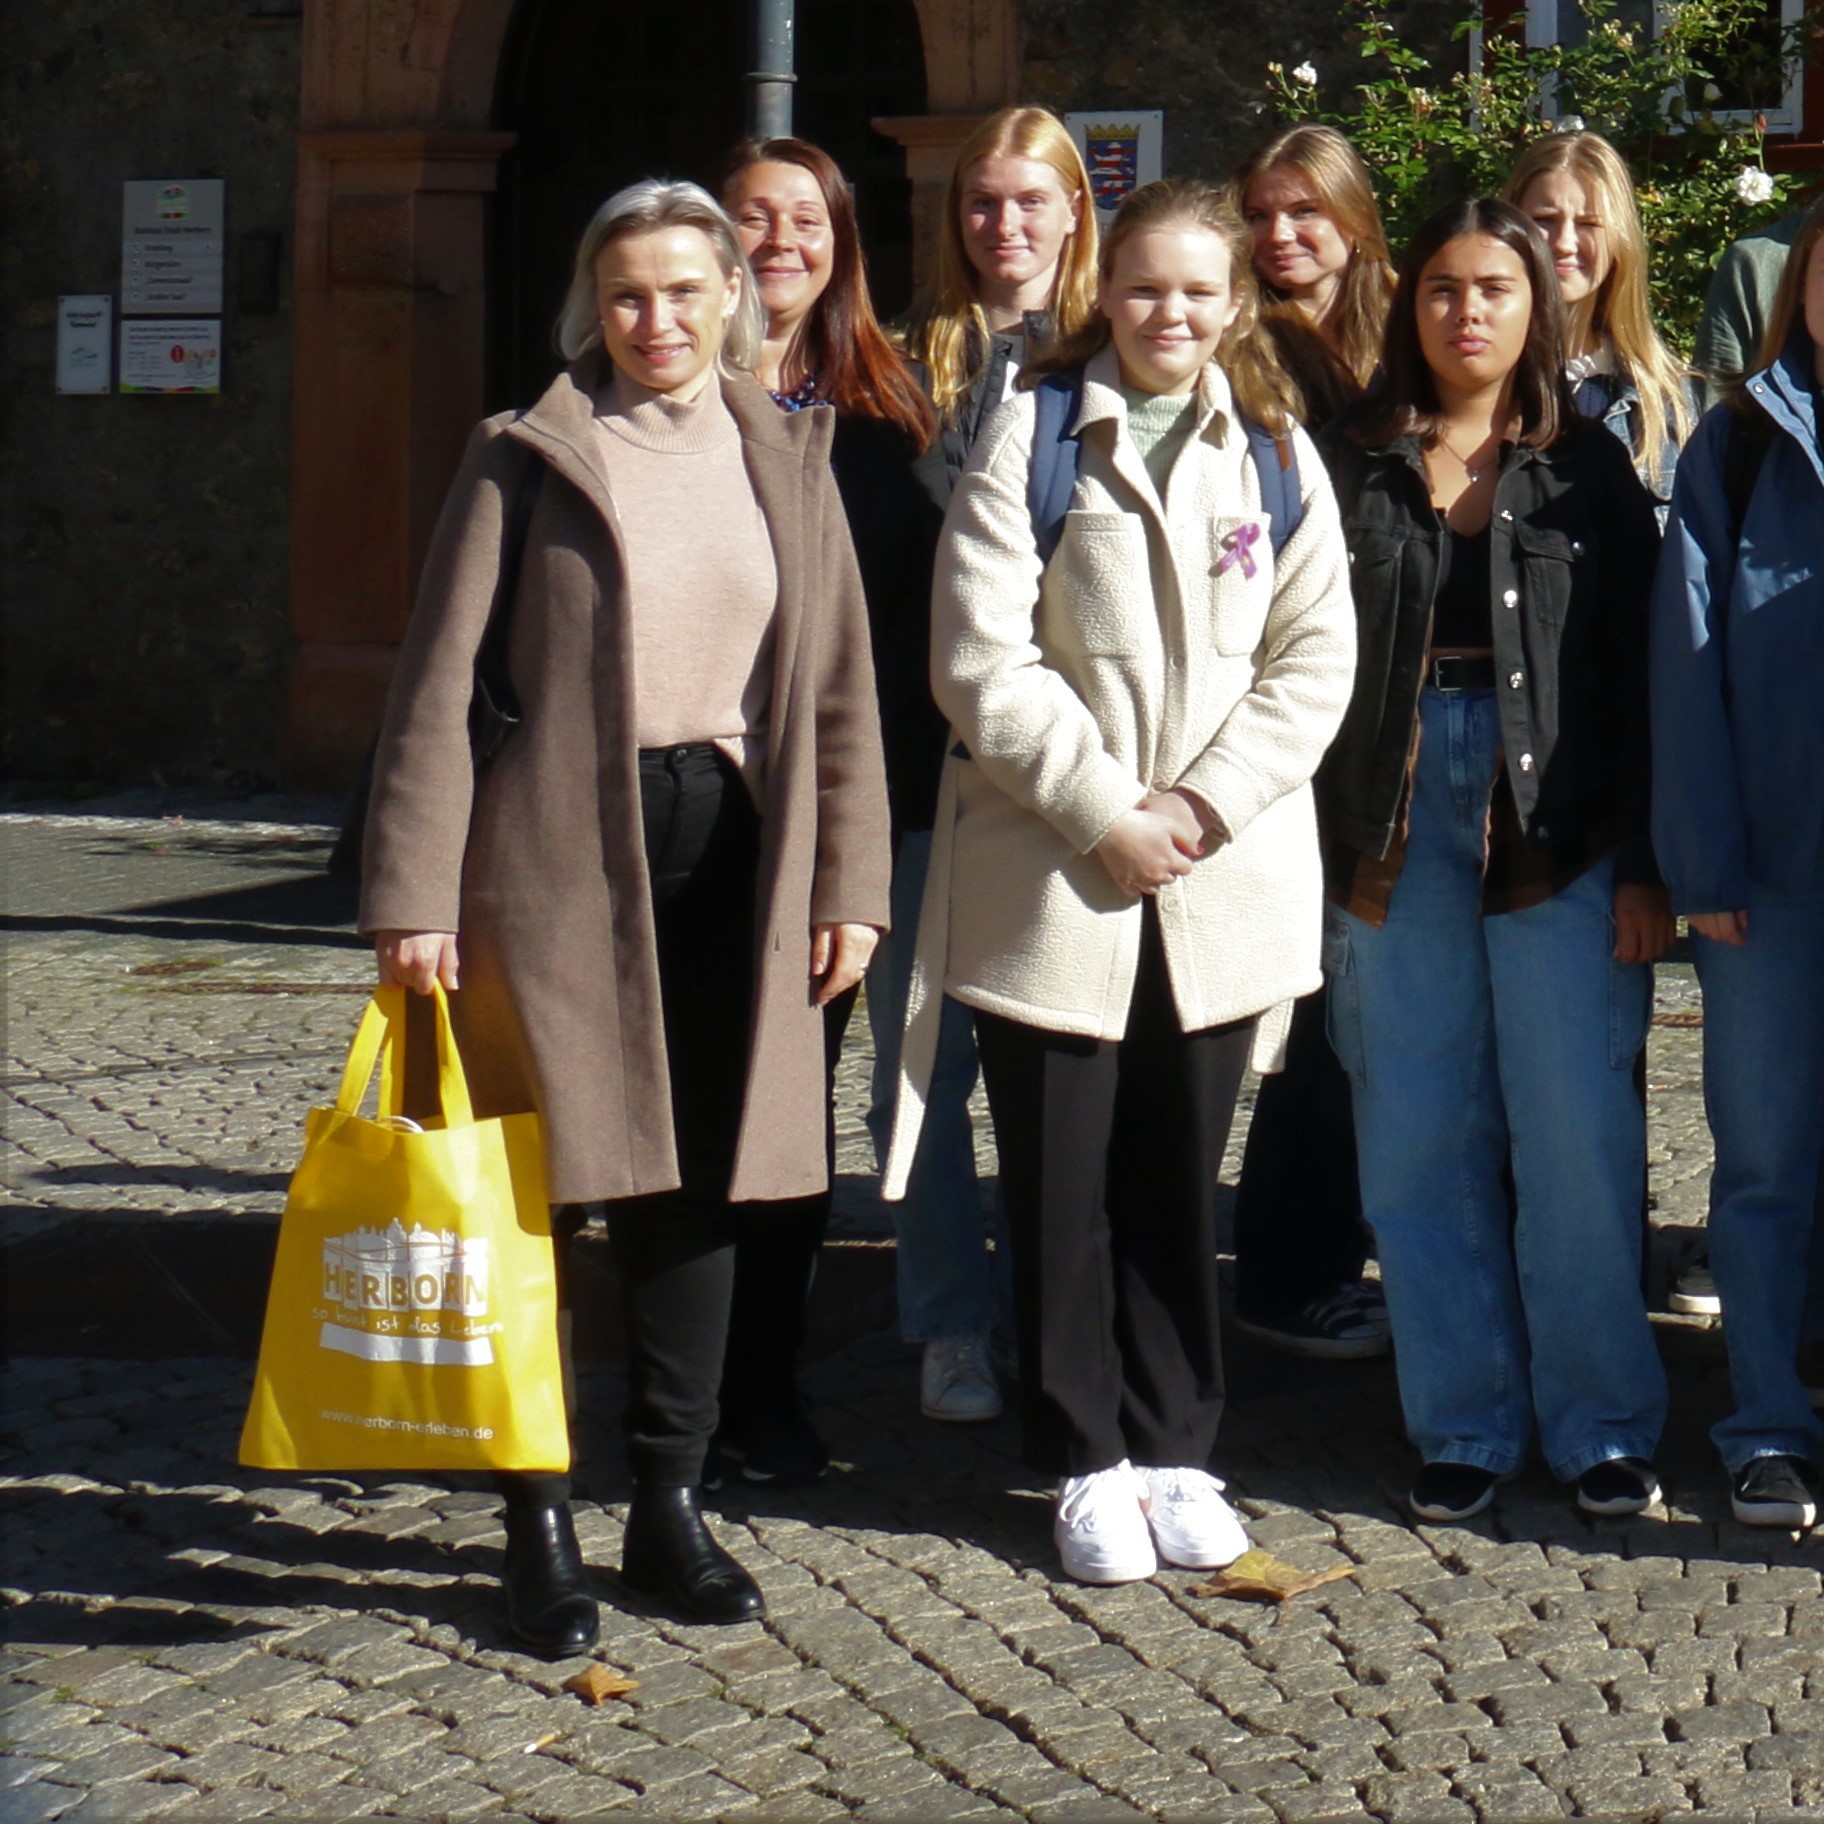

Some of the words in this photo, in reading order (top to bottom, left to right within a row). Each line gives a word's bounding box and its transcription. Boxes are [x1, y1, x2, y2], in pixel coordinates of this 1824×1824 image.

[325, 1261, 486, 1306] HERBORN
[376, 1315, 401, 1332] ist
[408, 1316, 441, 1333] das
